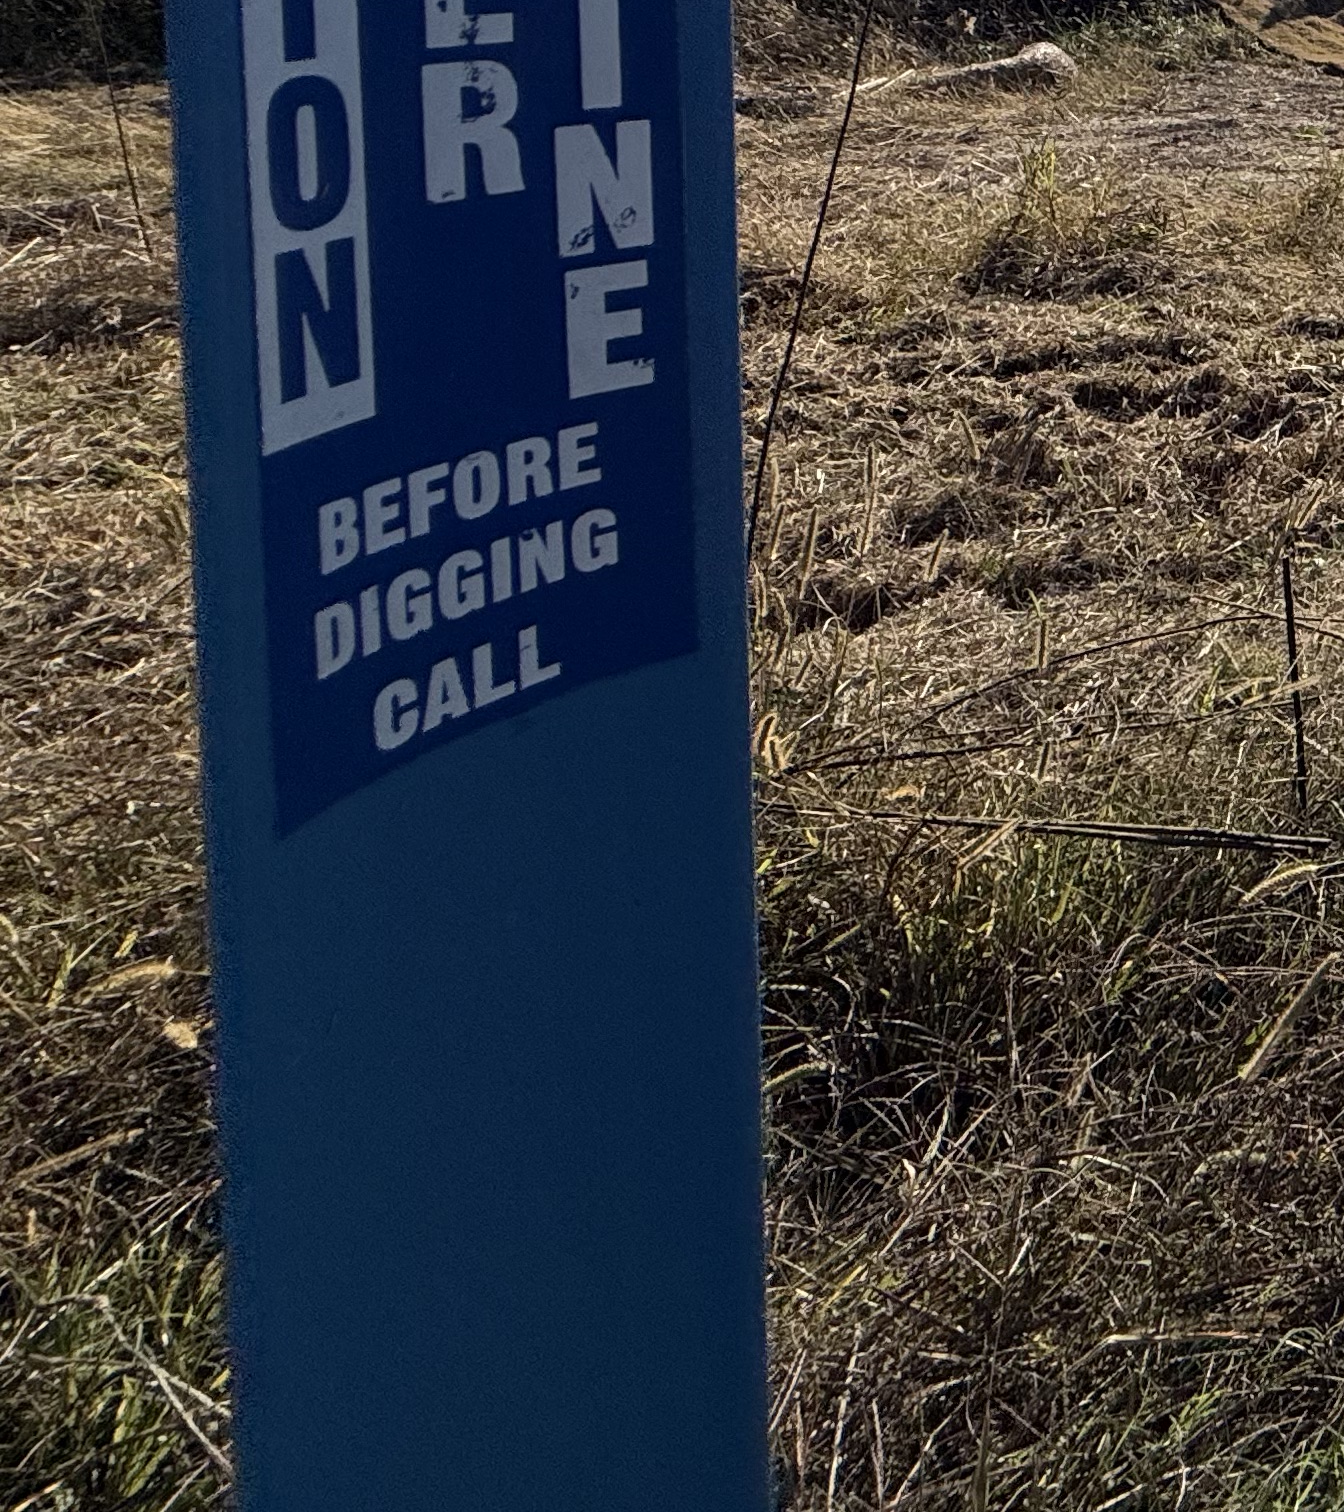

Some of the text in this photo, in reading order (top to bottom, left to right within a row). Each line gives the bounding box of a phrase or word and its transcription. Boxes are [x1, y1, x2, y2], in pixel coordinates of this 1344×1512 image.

[318, 421, 602, 576] BEFORE
[313, 509, 620, 681] DIGGING
[373, 626, 561, 753] CALL
